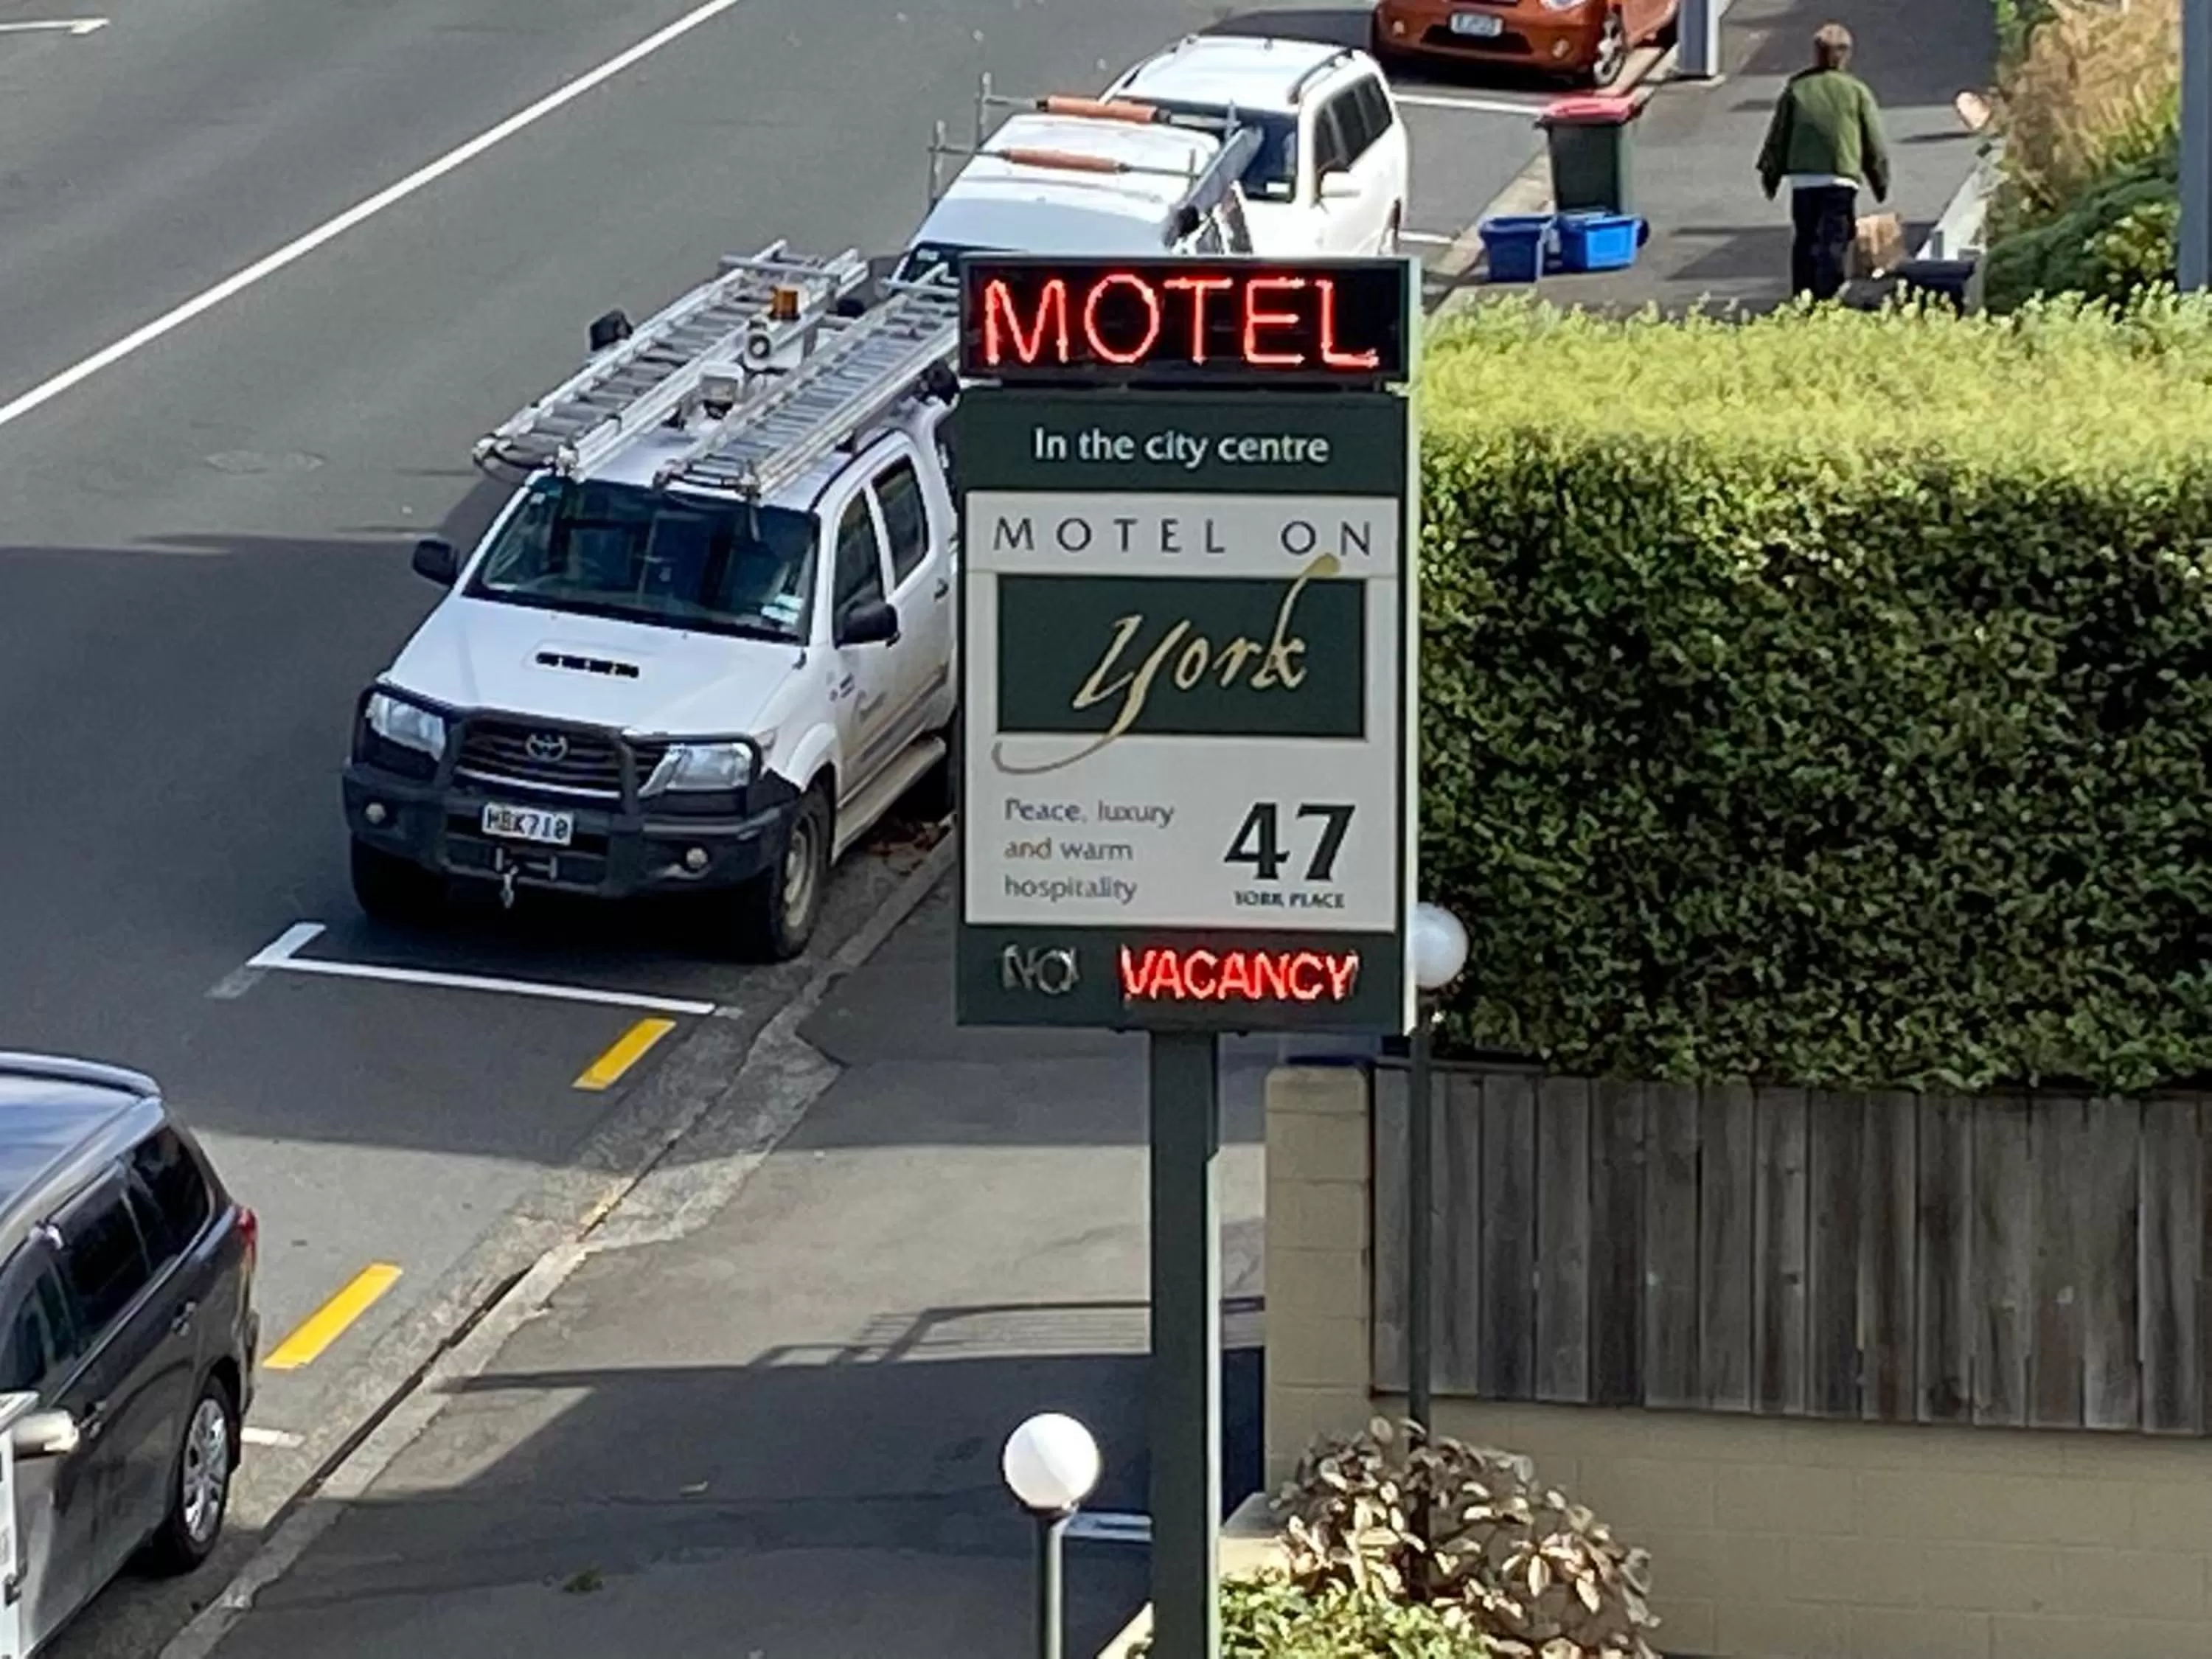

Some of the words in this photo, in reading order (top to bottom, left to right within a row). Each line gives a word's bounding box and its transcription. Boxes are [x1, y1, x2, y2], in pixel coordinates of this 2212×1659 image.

[984, 274, 1380, 367] MOTEL
[1034, 428, 1067, 460] In
[1078, 429, 1134, 460] the
[1145, 431, 1209, 469] city
[1217, 435, 1330, 462] centre
[993, 518, 1225, 554] MOTEL
[1281, 520, 1371, 557] ON
[1097, 800, 1175, 829] luxury
[1004, 836, 1052, 860] and
[1059, 842, 1134, 860] warm
[1223, 801, 1357, 881] 47
[1004, 873, 1138, 905] hospitality
[1234, 891, 1284, 908] YORK
[1290, 891, 1345, 909] PLACE
[1001, 944, 1079, 995] NO
[1120, 944, 1360, 1001] VACANCY
